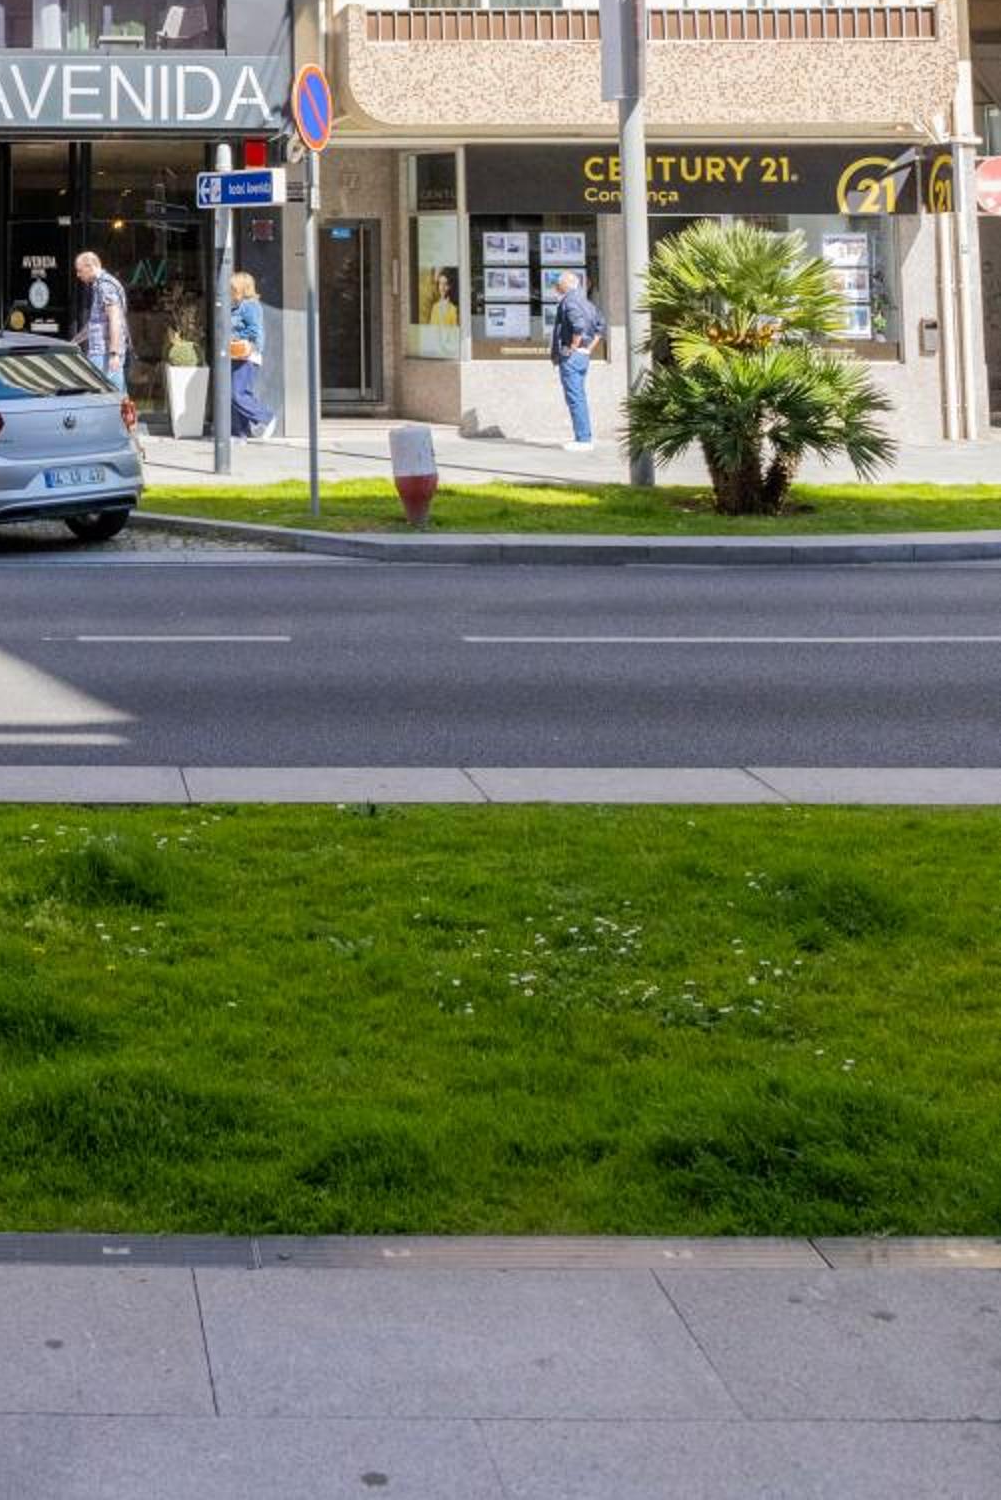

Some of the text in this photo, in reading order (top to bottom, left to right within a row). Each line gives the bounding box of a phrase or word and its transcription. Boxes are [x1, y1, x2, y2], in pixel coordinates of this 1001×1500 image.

[583, 156, 750, 183] CETURY
[583, 187, 680, 207] Connça
[856, 177, 896, 213] 21
